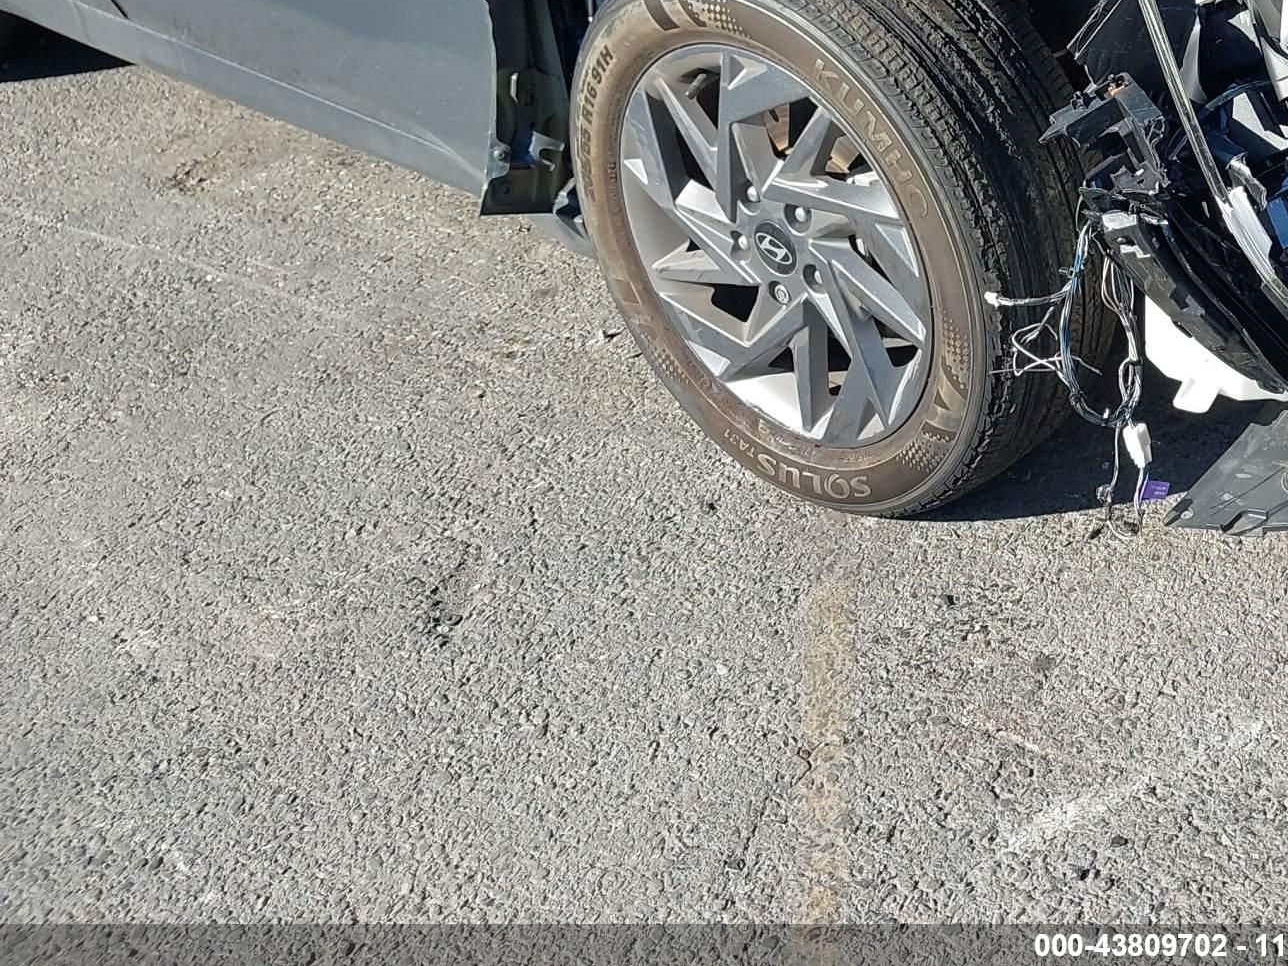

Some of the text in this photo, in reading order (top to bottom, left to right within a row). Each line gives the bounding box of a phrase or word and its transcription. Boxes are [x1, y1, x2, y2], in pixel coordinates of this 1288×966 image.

[580, 83, 598, 126] R16
[590, 44, 615, 85] 91H
[814, 58, 929, 219] KUMHO
[723, 427, 756, 459] TA31
[756, 453, 873, 499] SOLUS
